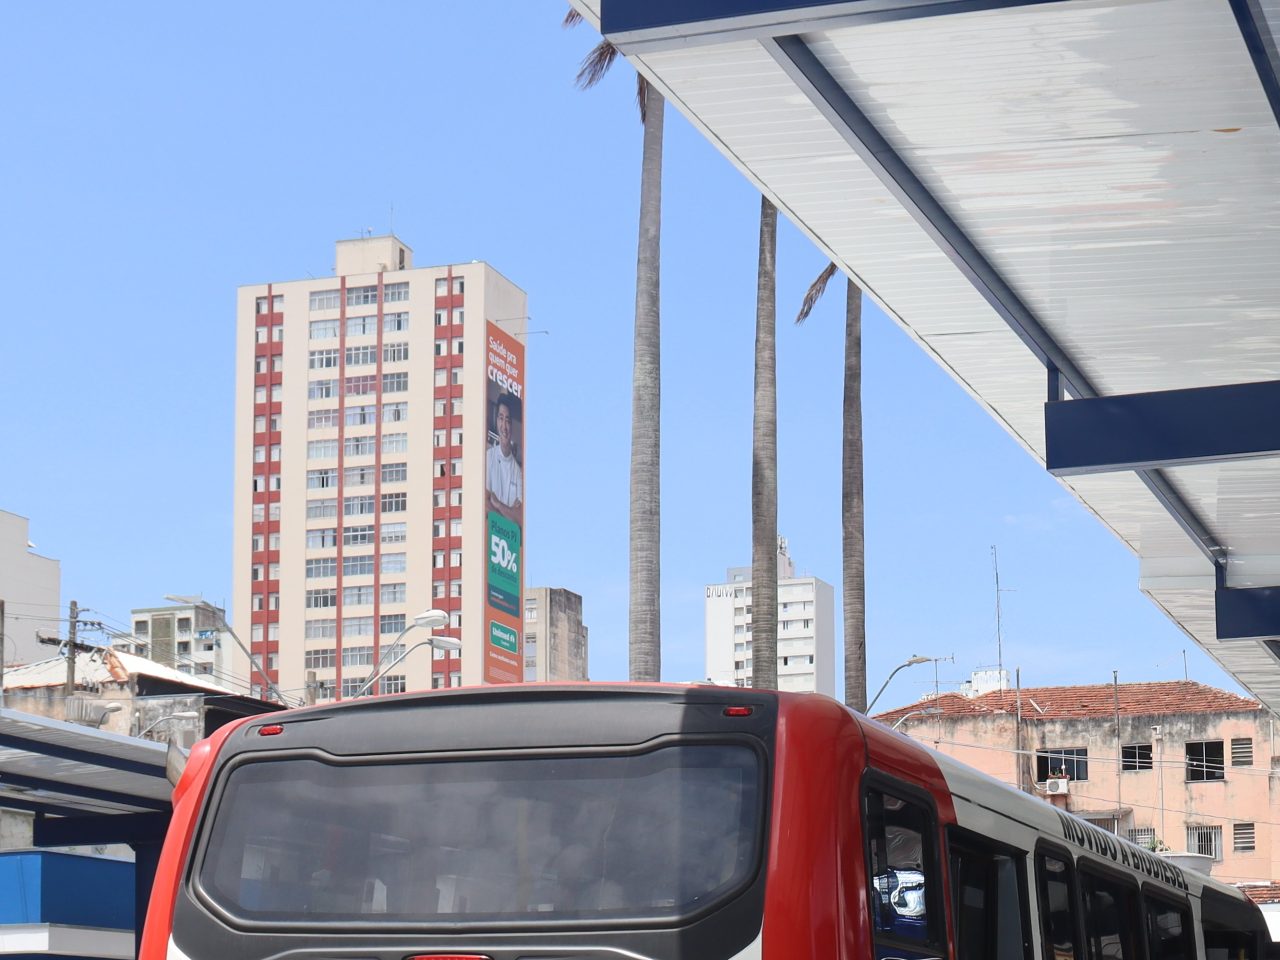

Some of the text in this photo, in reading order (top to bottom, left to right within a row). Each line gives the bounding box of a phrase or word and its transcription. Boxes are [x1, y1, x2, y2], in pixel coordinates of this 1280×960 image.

[489, 336, 507, 358] Saúde
[488, 365, 522, 398] crescer
[489, 352, 519, 378] quem quer
[491, 534, 517, 573] 50%
[1054, 808, 1117, 861] MOVIDO
[1127, 842, 1188, 891] BIODIESEL
